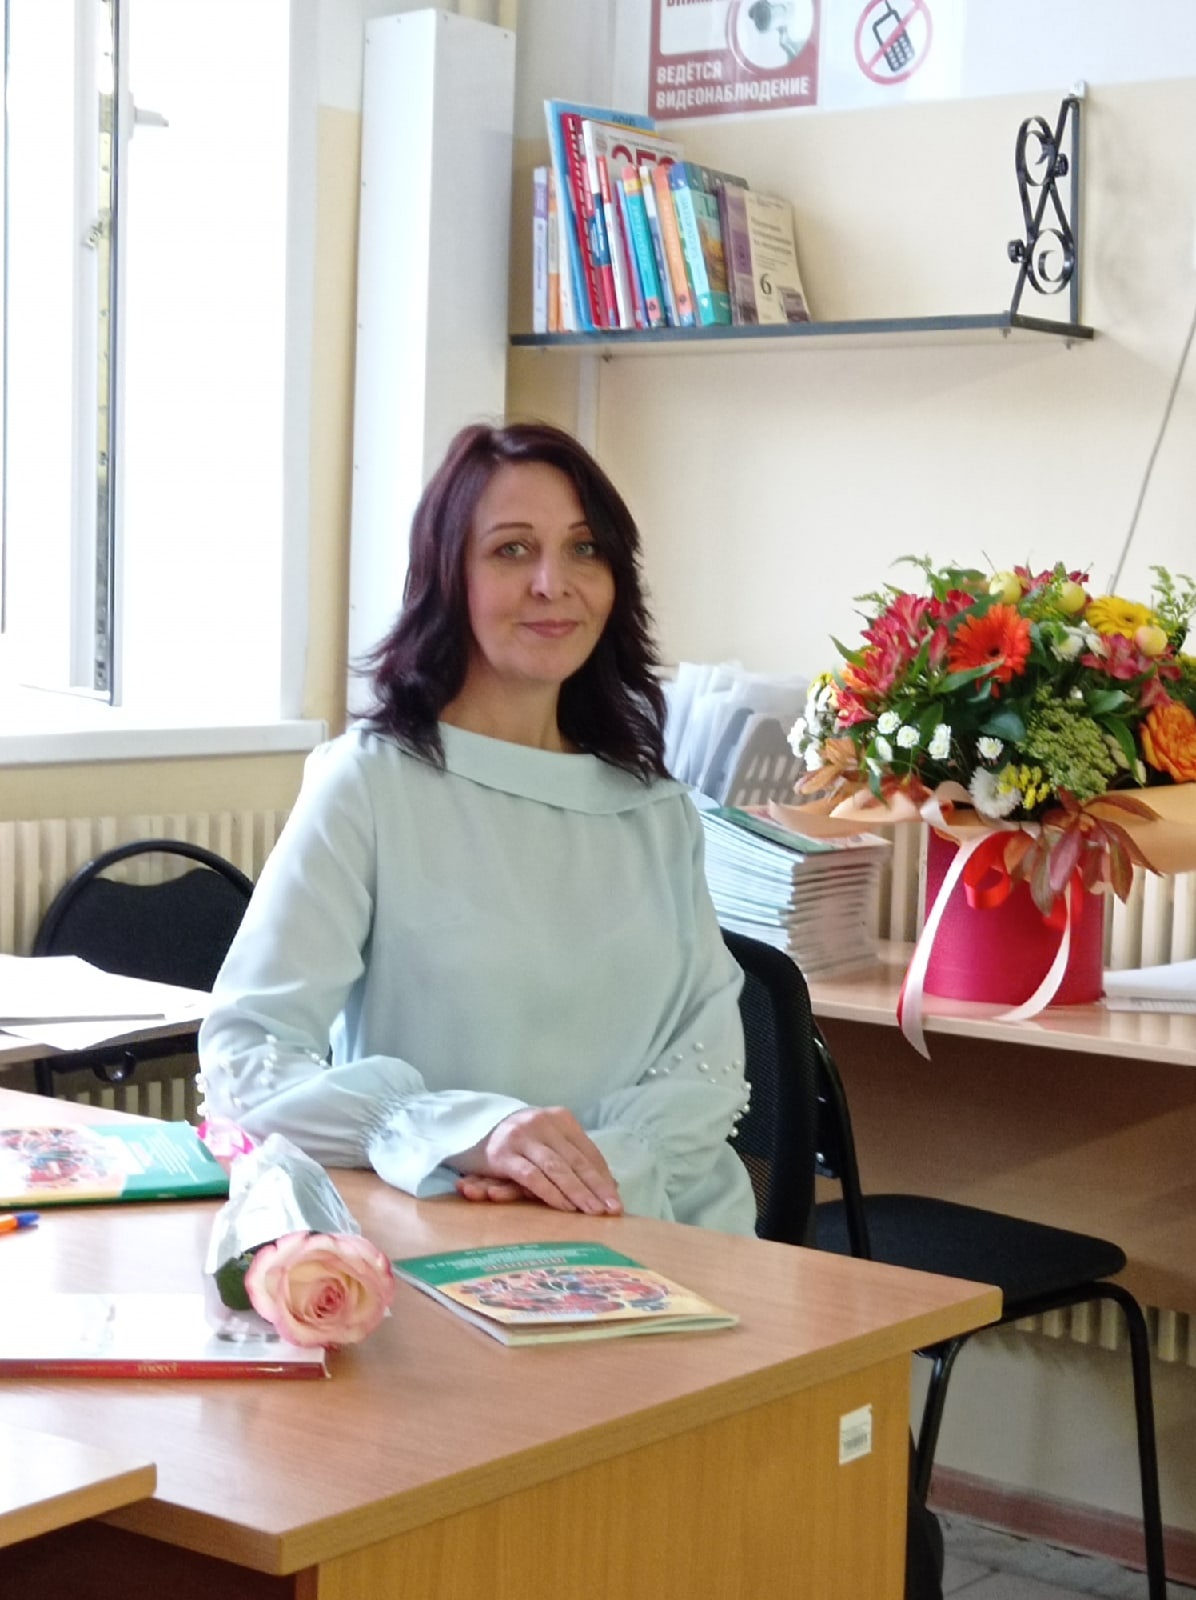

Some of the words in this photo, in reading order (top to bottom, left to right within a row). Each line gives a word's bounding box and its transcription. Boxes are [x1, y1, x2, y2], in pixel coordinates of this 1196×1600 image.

[656, 60, 722, 85] ВЕДЁТСЯ
[655, 76, 810, 110] ВИДЕОНАБЛЮДЕНИЕ
[760, 273, 772, 295] 6
